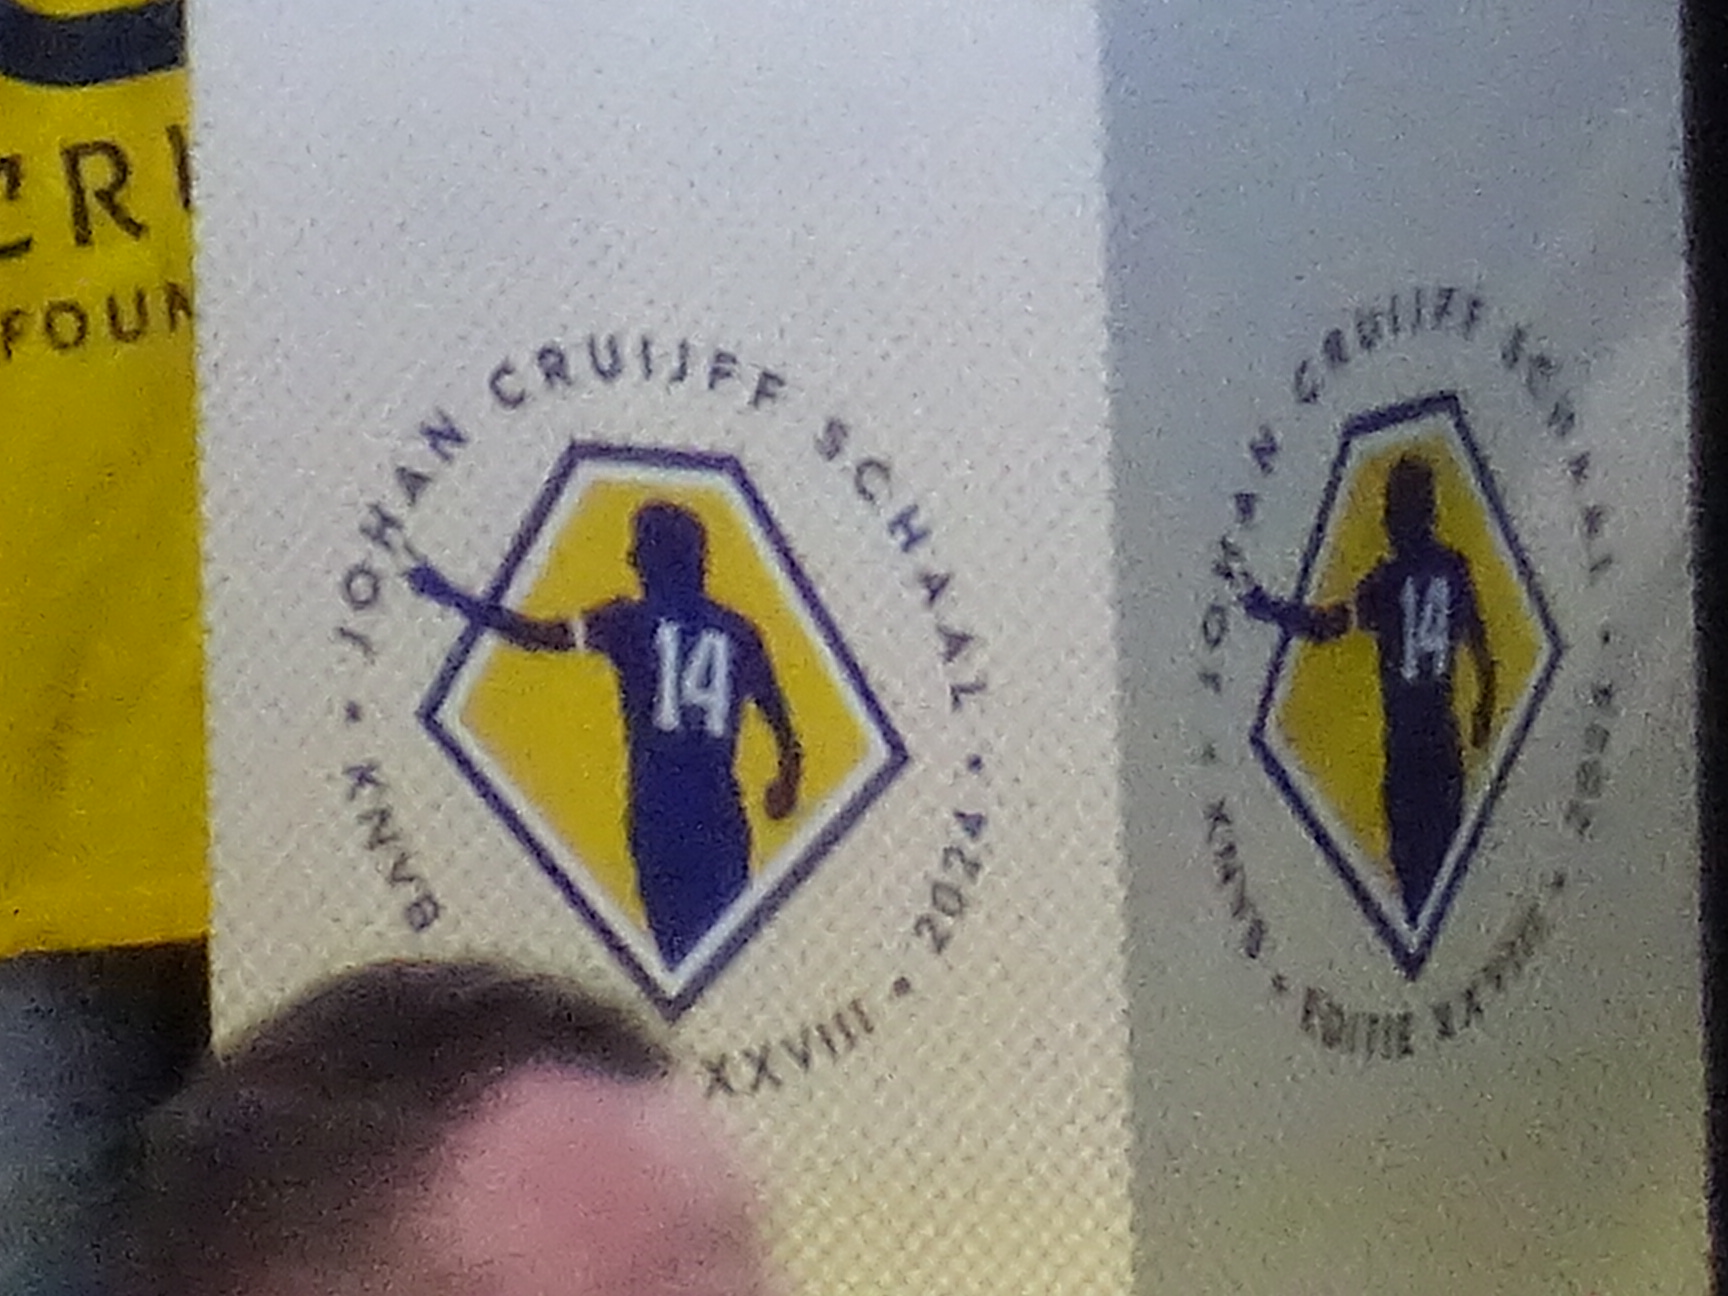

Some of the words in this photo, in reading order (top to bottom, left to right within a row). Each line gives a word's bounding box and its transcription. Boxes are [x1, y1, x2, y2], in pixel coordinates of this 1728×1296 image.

[338, 406, 472, 660] JOHAN
[486, 332, 791, 411] CRUIJFF
[812, 414, 991, 715] SCHAAL
[650, 616, 733, 739] 14
[1399, 572, 1455, 682] 14
[341, 758, 444, 936] KNVB
[911, 808, 991, 952] 2024
[702, 998, 876, 1100] XXVIII
